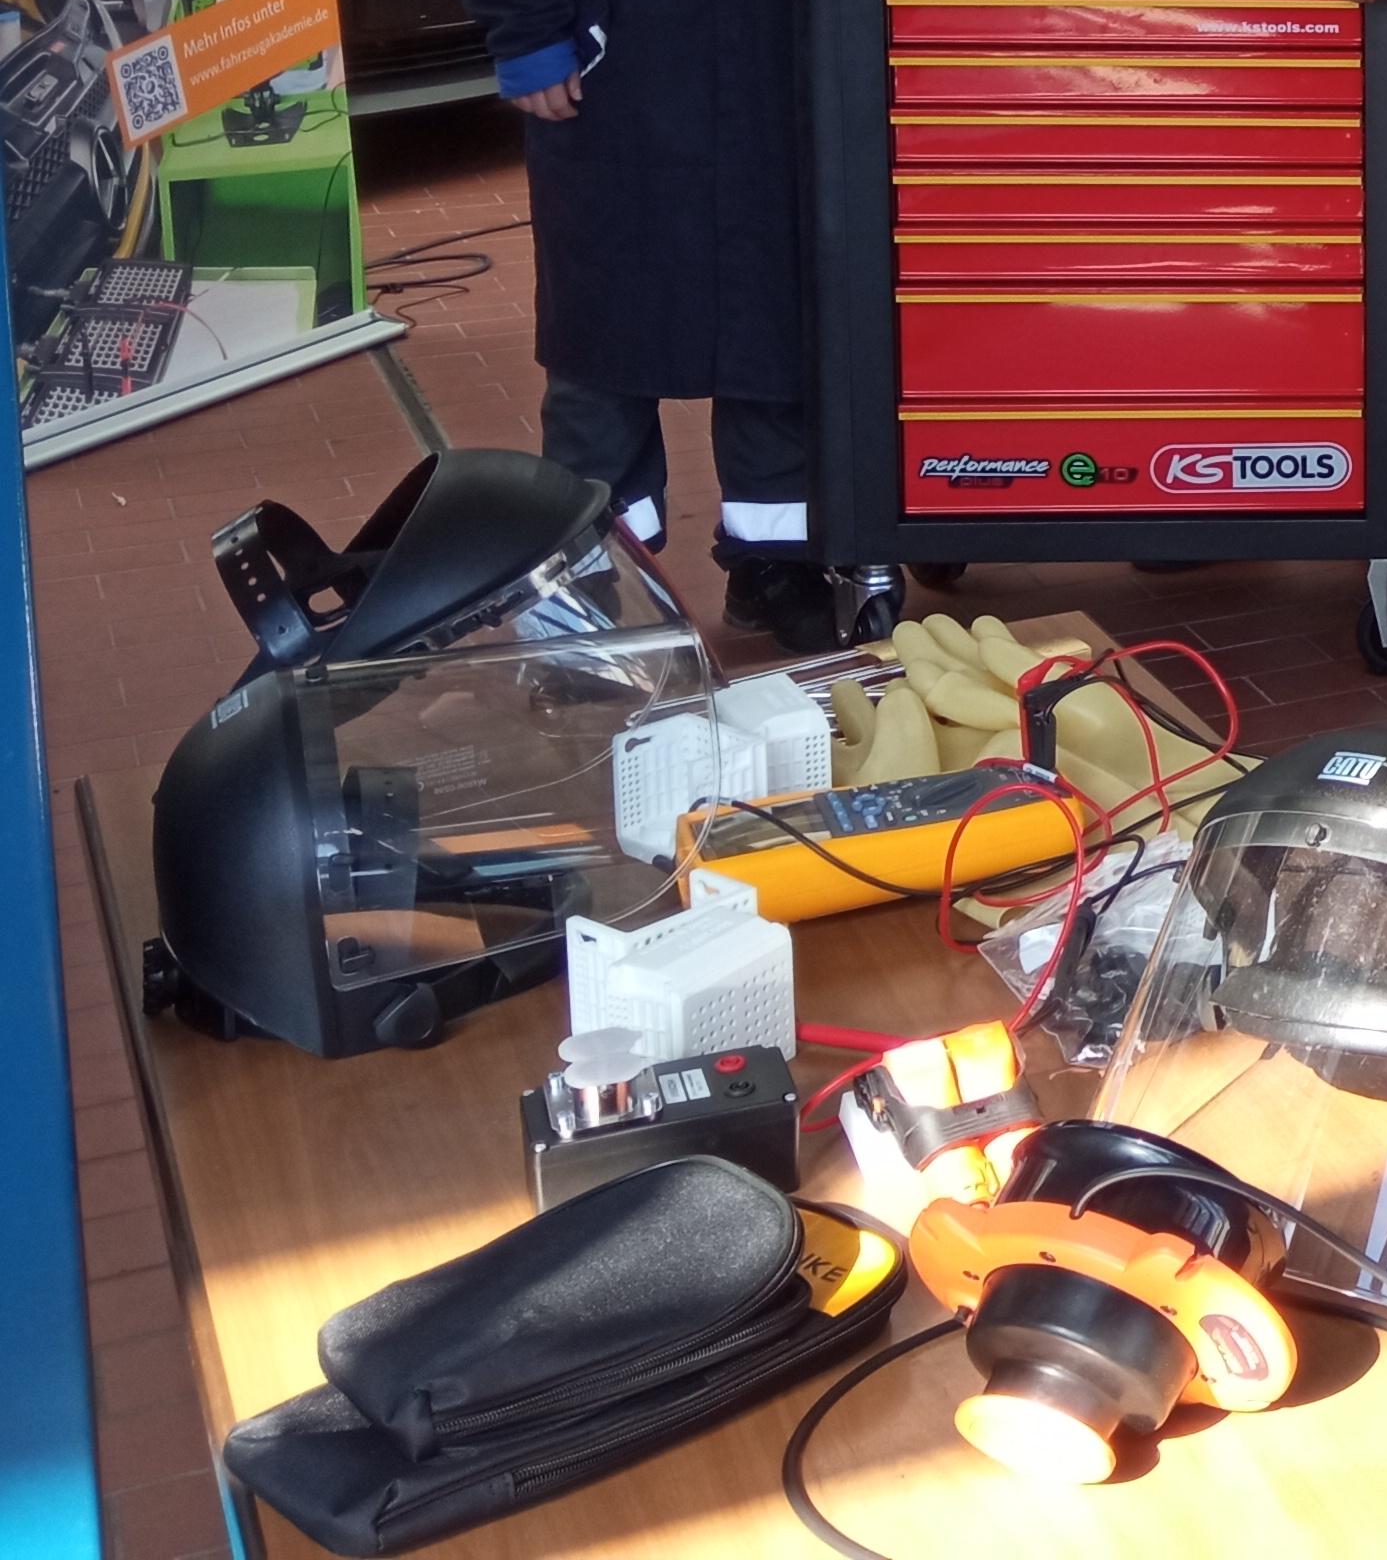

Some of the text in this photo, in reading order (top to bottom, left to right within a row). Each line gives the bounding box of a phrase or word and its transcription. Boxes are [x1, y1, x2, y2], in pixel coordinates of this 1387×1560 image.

[182, 32, 219, 60] Mehr
[219, 14, 252, 41] Infos
[1195, 20, 1340, 34] www.kstools.com
[190, 8, 329, 86] www.fahrzeugakademie.de
[919, 454, 1050, 481] performance
[1232, 453, 1336, 480] TOOLS
